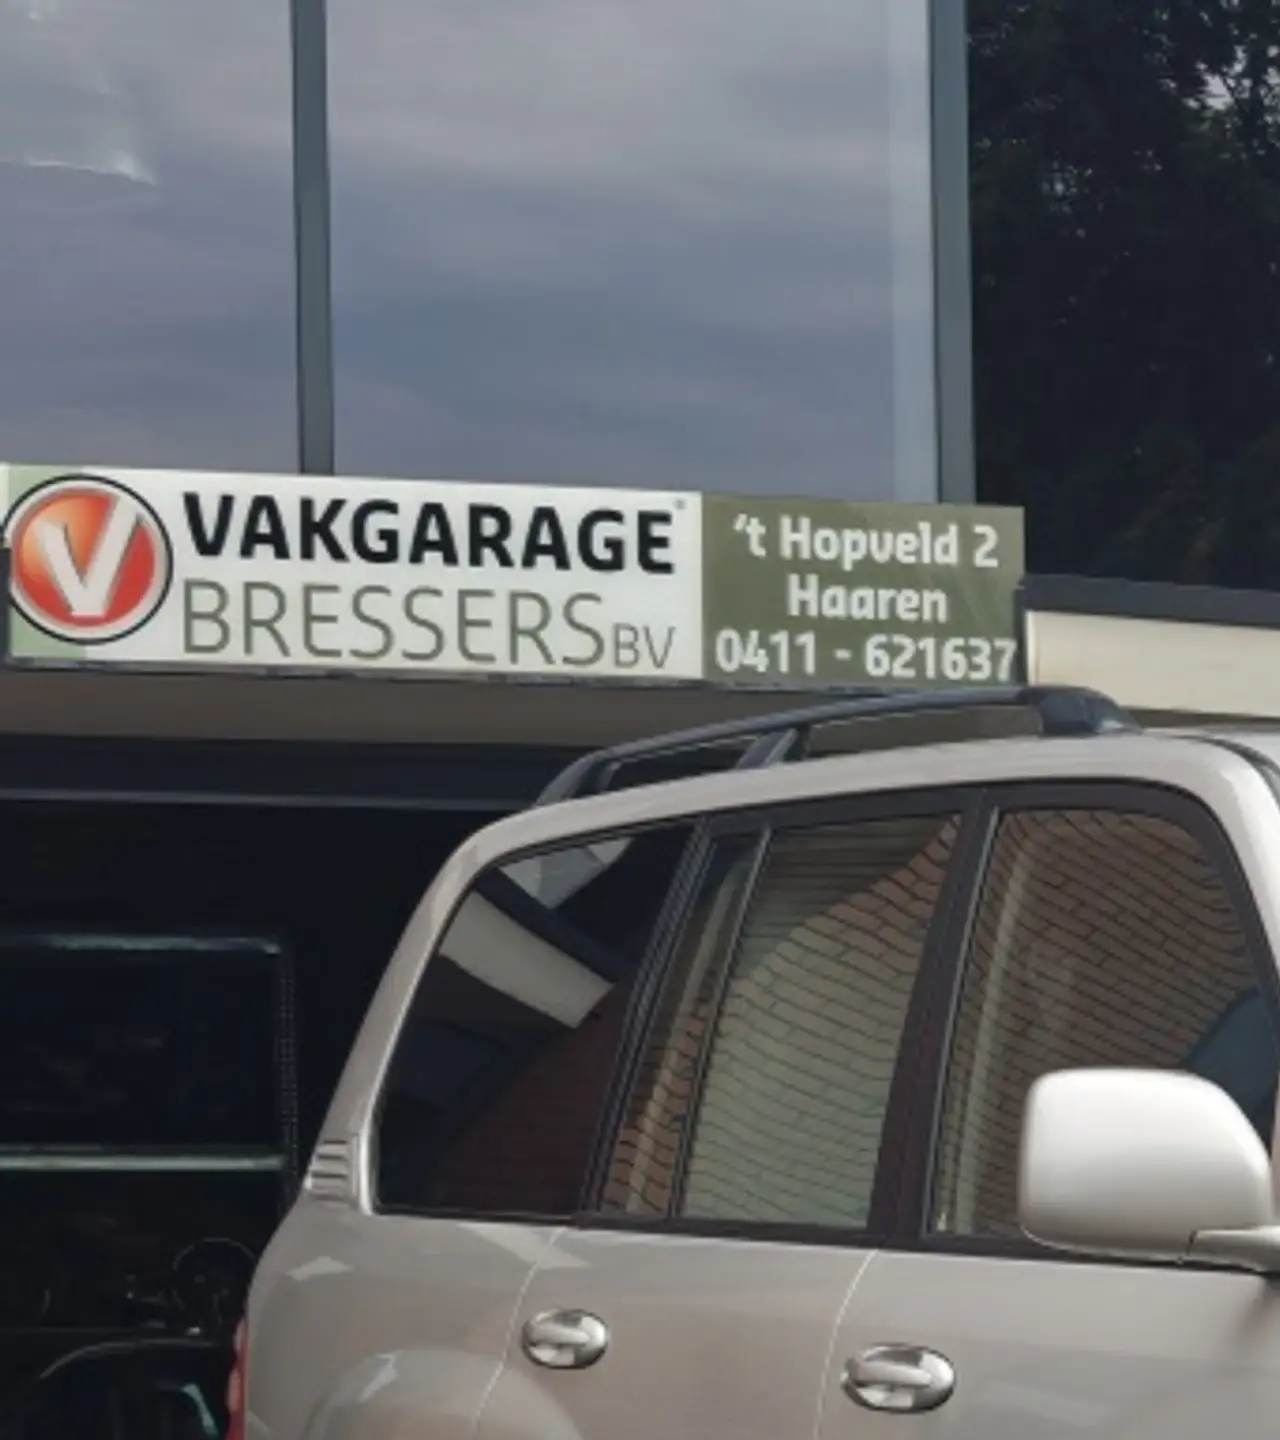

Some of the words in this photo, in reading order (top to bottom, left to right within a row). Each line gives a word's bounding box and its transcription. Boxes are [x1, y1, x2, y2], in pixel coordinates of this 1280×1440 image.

[182, 491, 674, 575] VAKGARAGE
[779, 513, 959, 572] Hopveld
[972, 523, 1000, 568] 2
[183, 577, 605, 667] BRESSERS
[613, 621, 676, 669] BV
[787, 572, 948, 623] Haaren
[715, 627, 817, 676] 0411
[864, 633, 1018, 682] 621637
